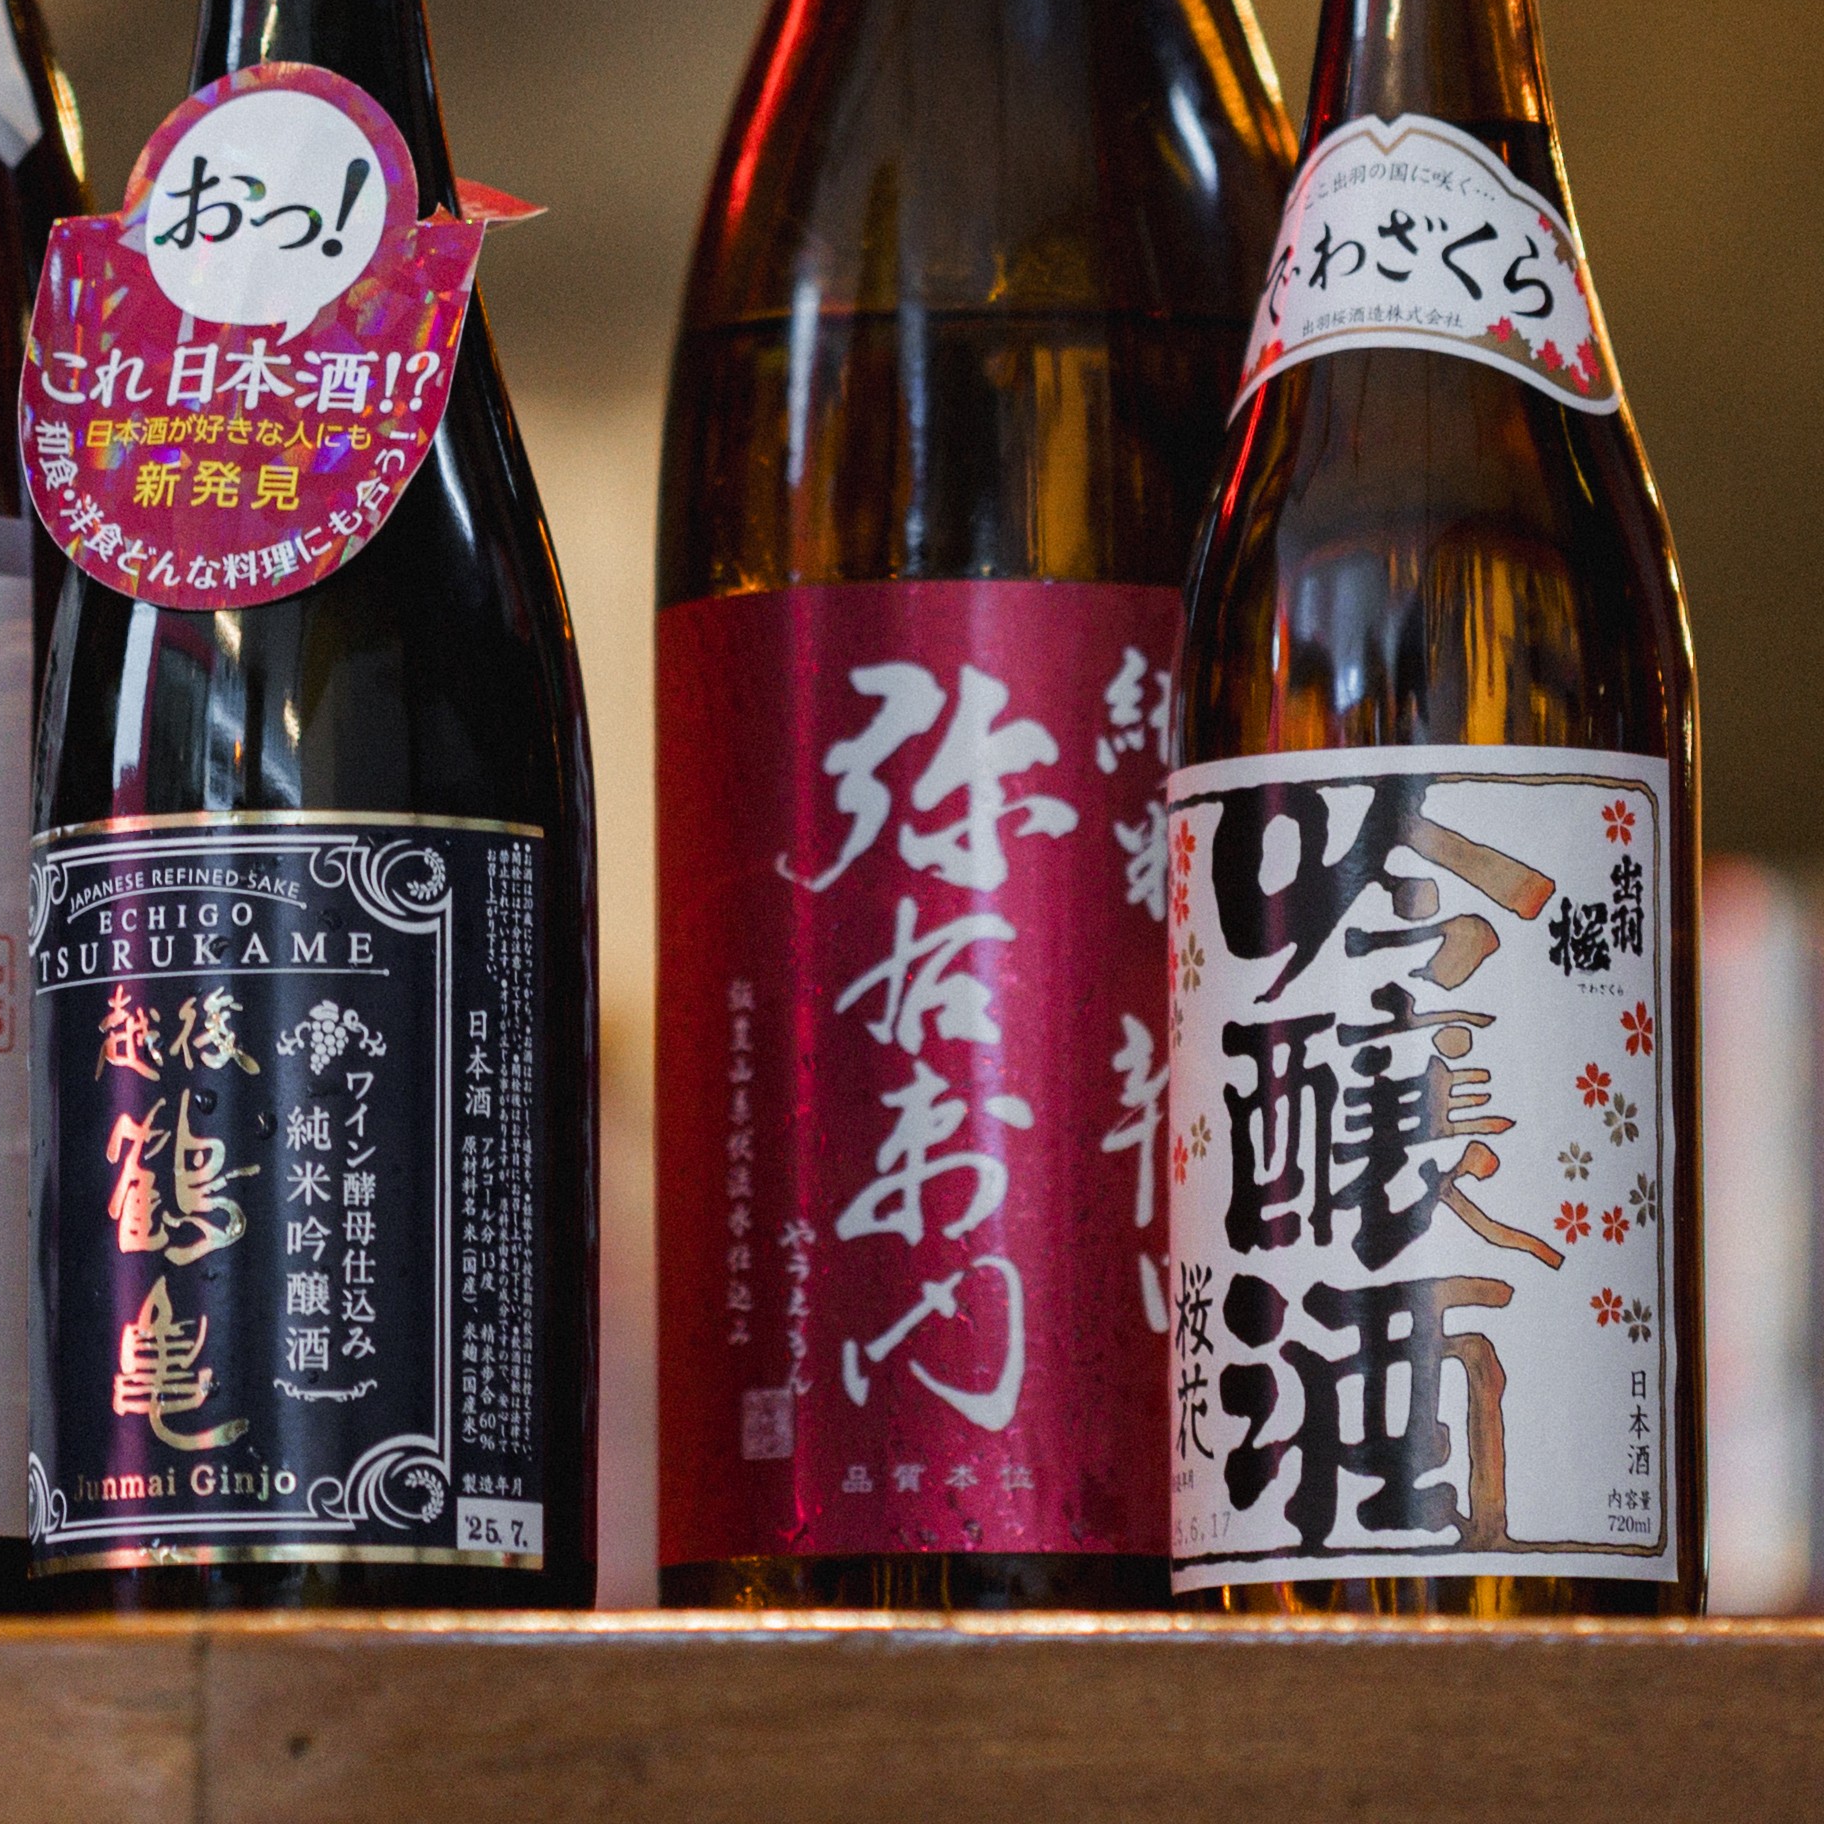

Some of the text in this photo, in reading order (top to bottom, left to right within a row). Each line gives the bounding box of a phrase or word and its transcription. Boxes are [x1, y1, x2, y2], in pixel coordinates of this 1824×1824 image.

[85, 413, 373, 452] 日本酒が好きな人にも
[132, 459, 301, 512] 新発見
[69, 867, 301, 914] JAPANESE REFINED SAKE
[98, 901, 254, 935] ECHIGO
[39, 931, 375, 983] TSURUKAME
[464, 1009, 494, 1120] 日本酒
[461, 1134, 479, 1217] 原材料名
[1212, 776, 1565, 1549] 吟醸酒
[283, 1105, 333, 1374] 純米吟醸酒
[342, 1070, 377, 1360] ワイン酵母仕込み
[1175, 1261, 1215, 1462] 桜花
[1627, 1369, 1651, 1477] 日本酒
[73, 1463, 298, 1503] Junmai Ginjo
[461, 1473, 525, 1498] 製造年月
[1607, 1487, 1652, 1512] 内容量
[1607, 1514, 1652, 1535] 720ml
